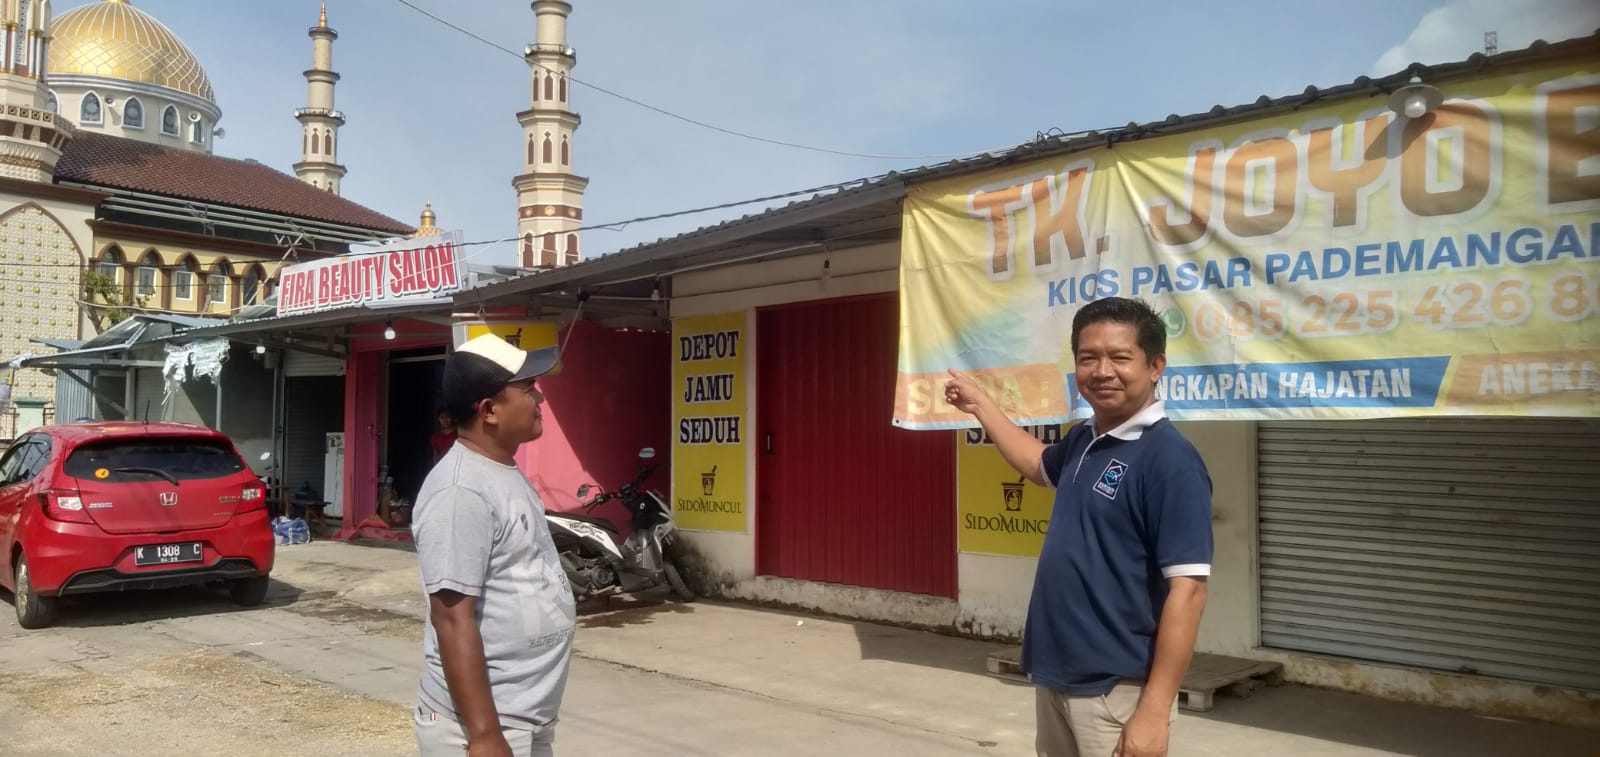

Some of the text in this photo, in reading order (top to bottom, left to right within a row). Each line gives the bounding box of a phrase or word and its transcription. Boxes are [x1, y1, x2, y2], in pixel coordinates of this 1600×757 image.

[970, 165, 1112, 276] TK.
[1149, 102, 1492, 247] JOYO
[279, 241, 457, 313] FIRA BEAUTY SALON
[1047, 268, 1120, 308] KIOS
[1132, 256, 1251, 296] PASAR
[1194, 299, 1284, 340] 085
[1301, 289, 1395, 334] 225
[1414, 279, 1526, 325] 426
[679, 331, 739, 362] DEPOT
[684, 374, 734, 403] JAMU
[1278, 367, 1413, 399] HAJATAN
[679, 416, 740, 444] SEDUH
[137, 543, 200, 559] K 1308 C
